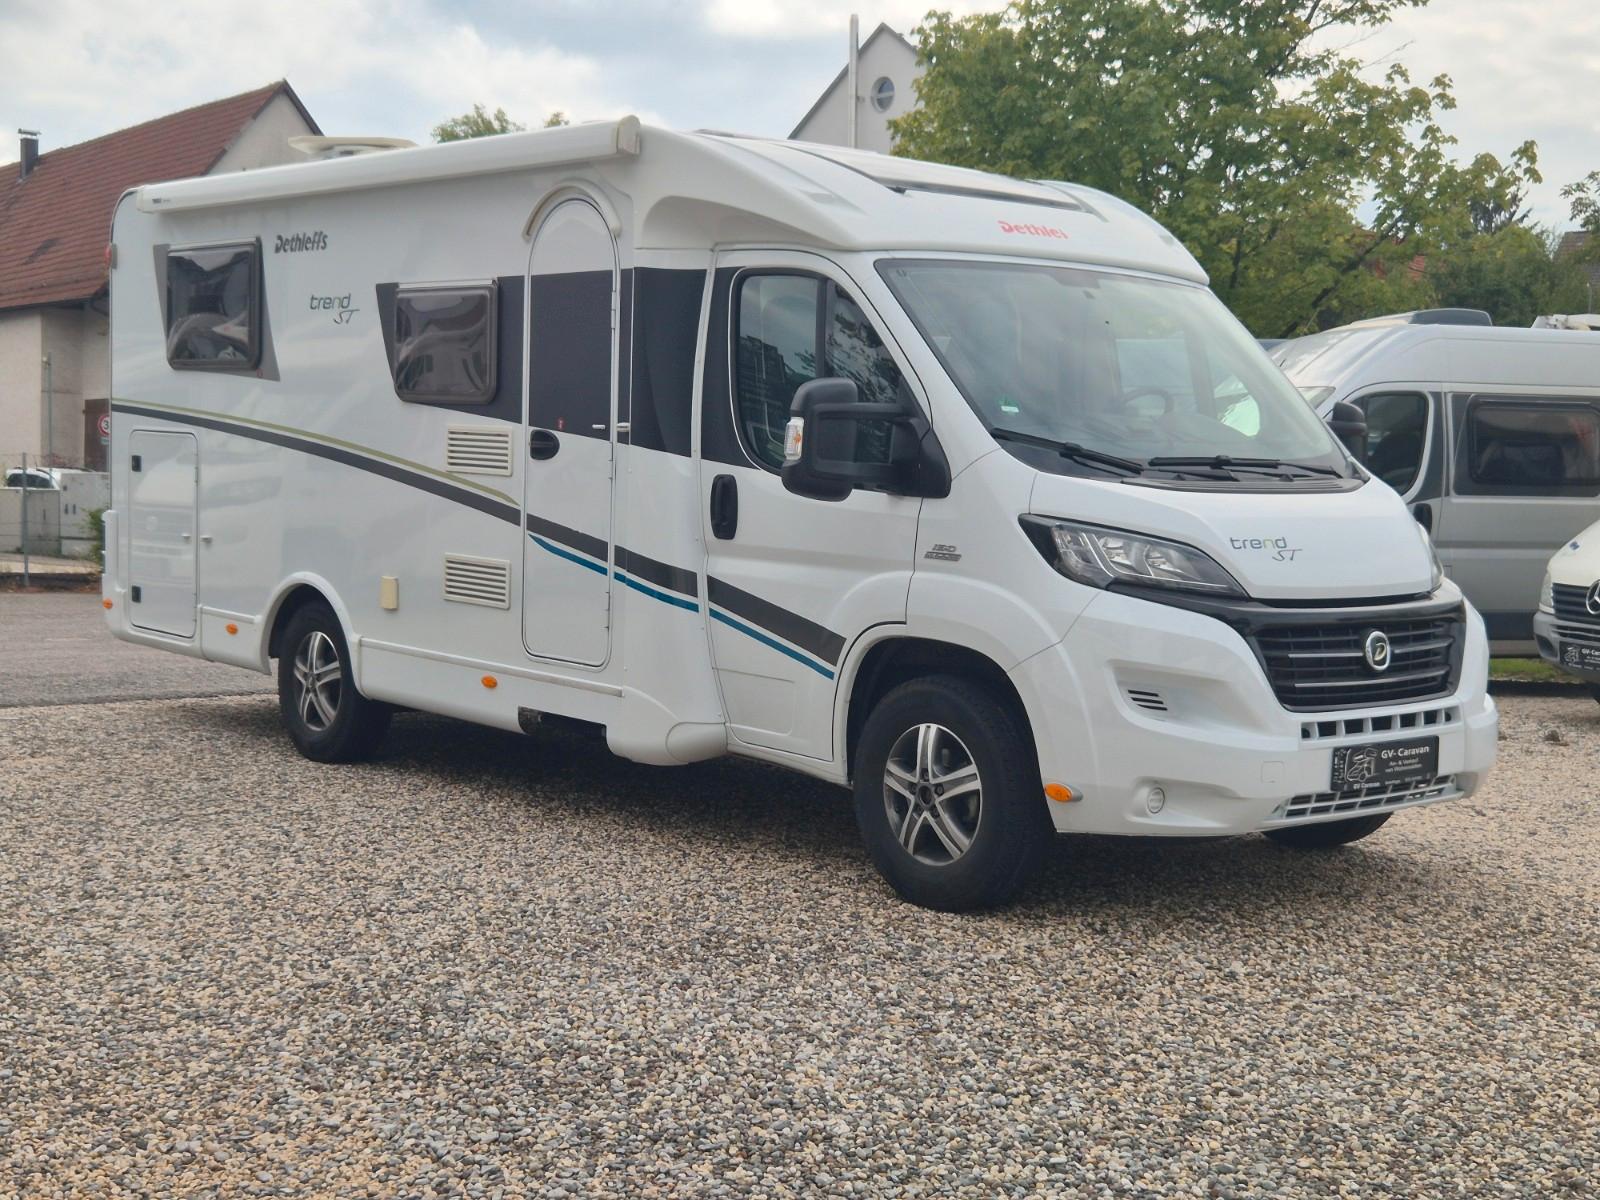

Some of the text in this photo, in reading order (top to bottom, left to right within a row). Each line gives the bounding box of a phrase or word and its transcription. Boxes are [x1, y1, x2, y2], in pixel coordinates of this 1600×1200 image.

[274, 230, 328, 254] Dethleffs
[309, 292, 351, 311] trend
[332, 308, 360, 325] ST
[1229, 536, 1288, 550] trend
[1271, 548, 1303, 562] ST
[1397, 745, 1430, 757] Caravan
